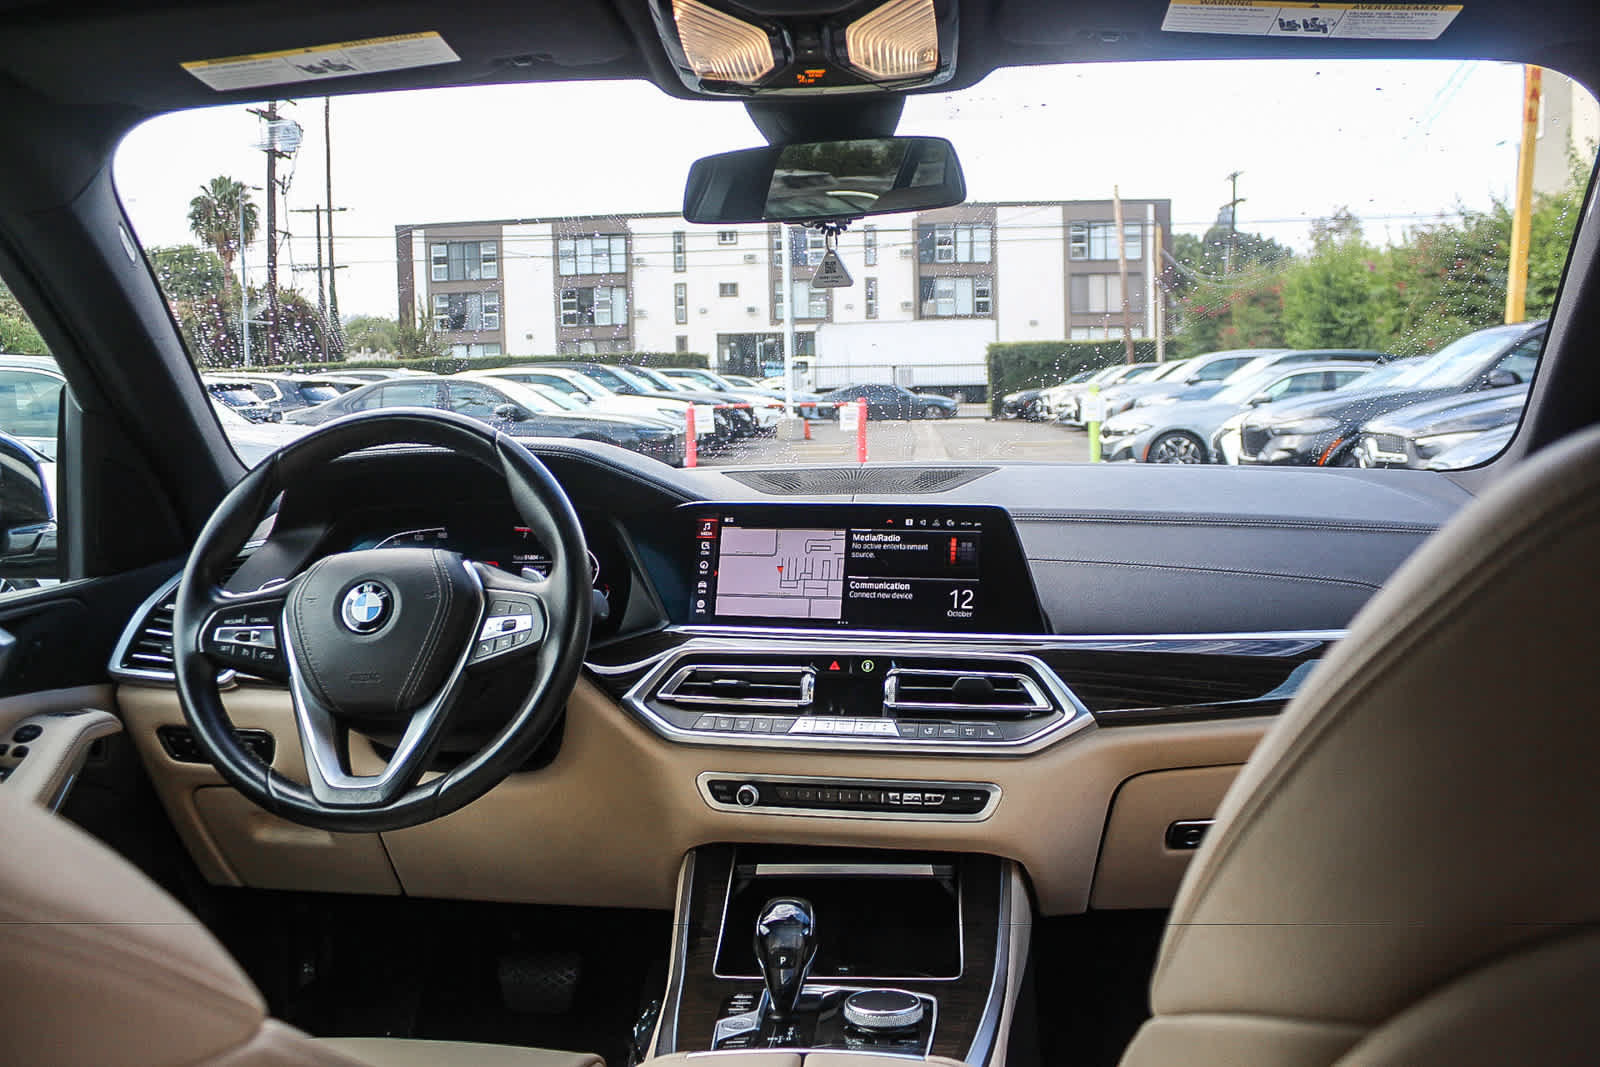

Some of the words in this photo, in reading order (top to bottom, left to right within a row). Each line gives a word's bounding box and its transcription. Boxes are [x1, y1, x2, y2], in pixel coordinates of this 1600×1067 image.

[852, 533, 901, 542] Media/Radio
[883, 543, 929, 551] entertainment
[849, 581, 910, 590] Communication
[849, 590, 876, 598] Connect
[891, 592, 913, 600] device
[949, 589, 974, 610] 12
[947, 610, 973, 618] October
[780, 956, 787, 965] P
